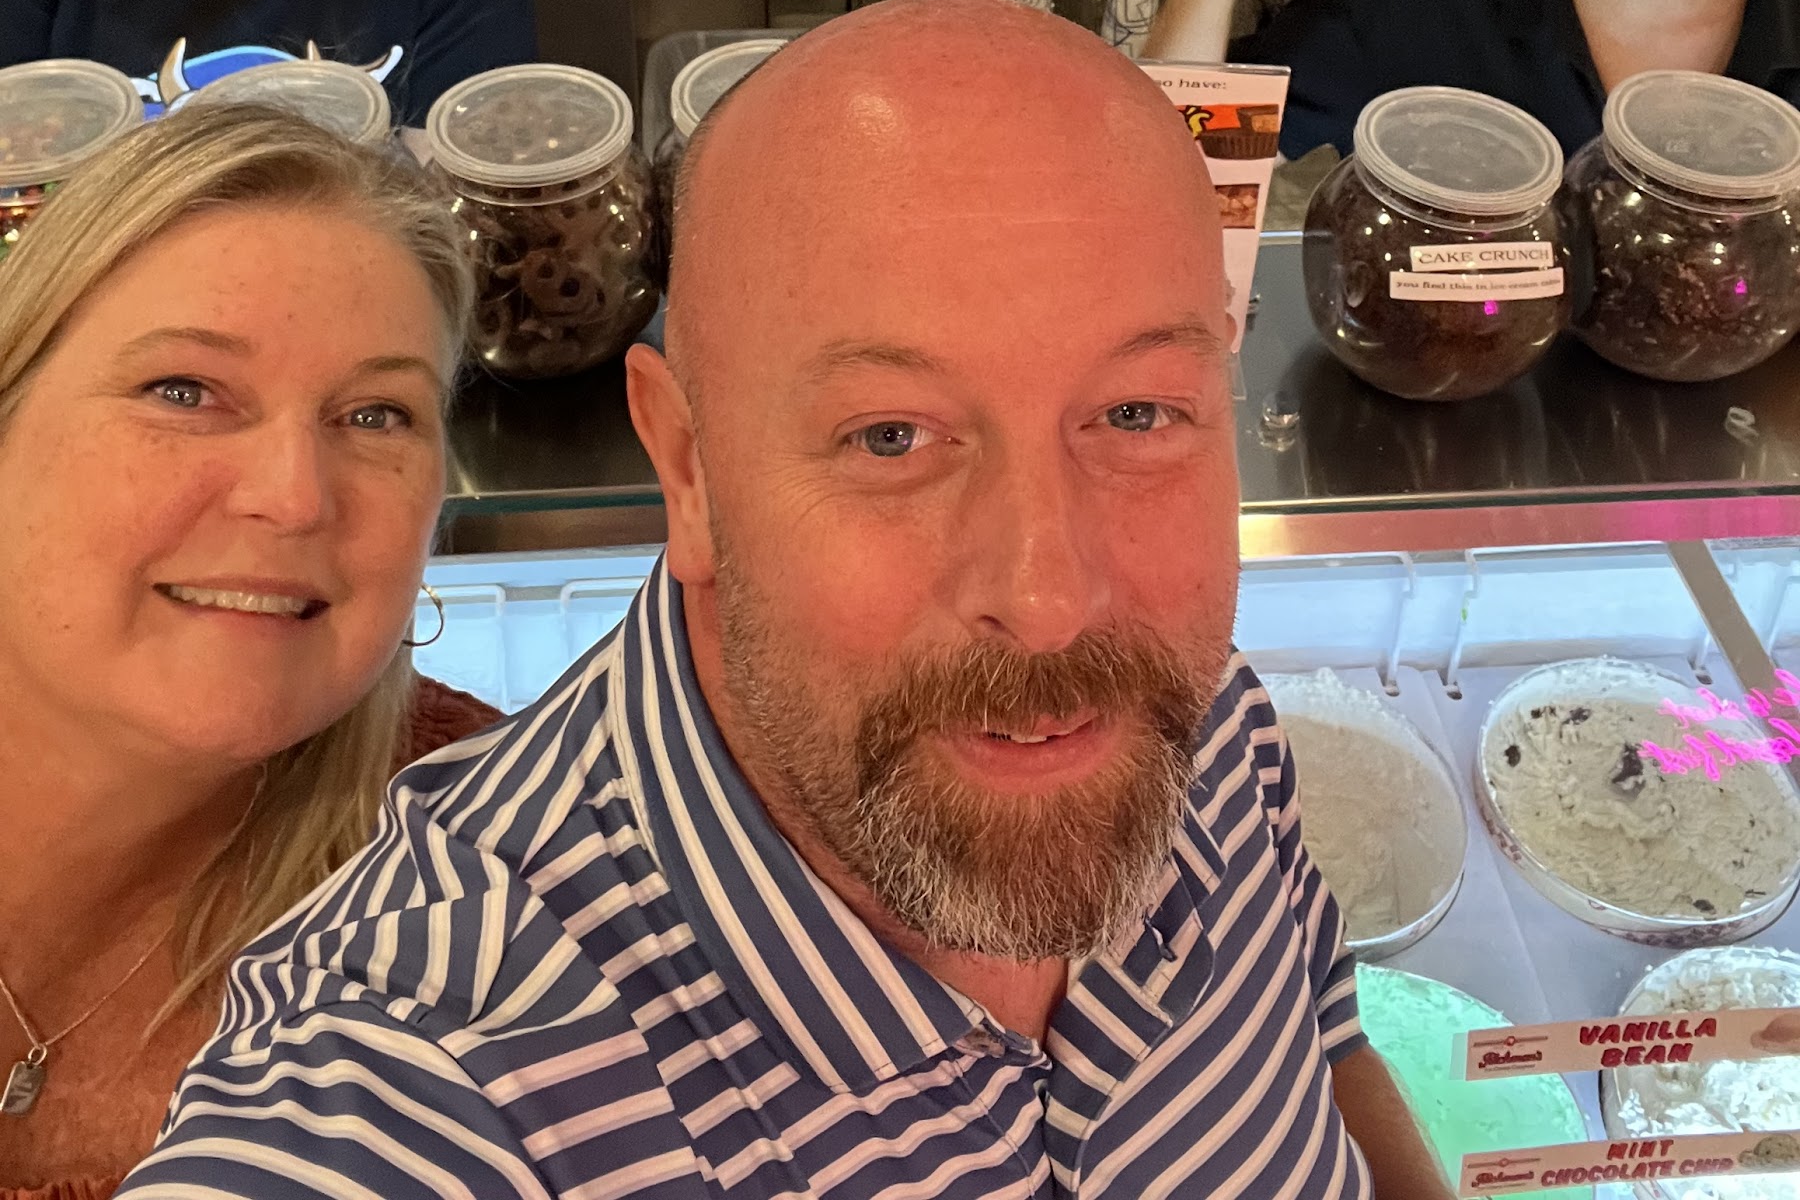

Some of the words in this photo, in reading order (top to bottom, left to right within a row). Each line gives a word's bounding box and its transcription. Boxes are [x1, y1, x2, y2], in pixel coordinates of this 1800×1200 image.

[1179, 79, 1227, 90] have:
[1419, 252, 1474, 264] CAKE
[1479, 249, 1549, 262] CRUNCH
[1423, 281, 1446, 289] find
[1579, 1018, 1717, 1046] VANILLA
[1600, 1043, 1693, 1068] BEAN
[1607, 1139, 1674, 1160] MINT
[1541, 1160, 1676, 1187] CHOCOLATE
